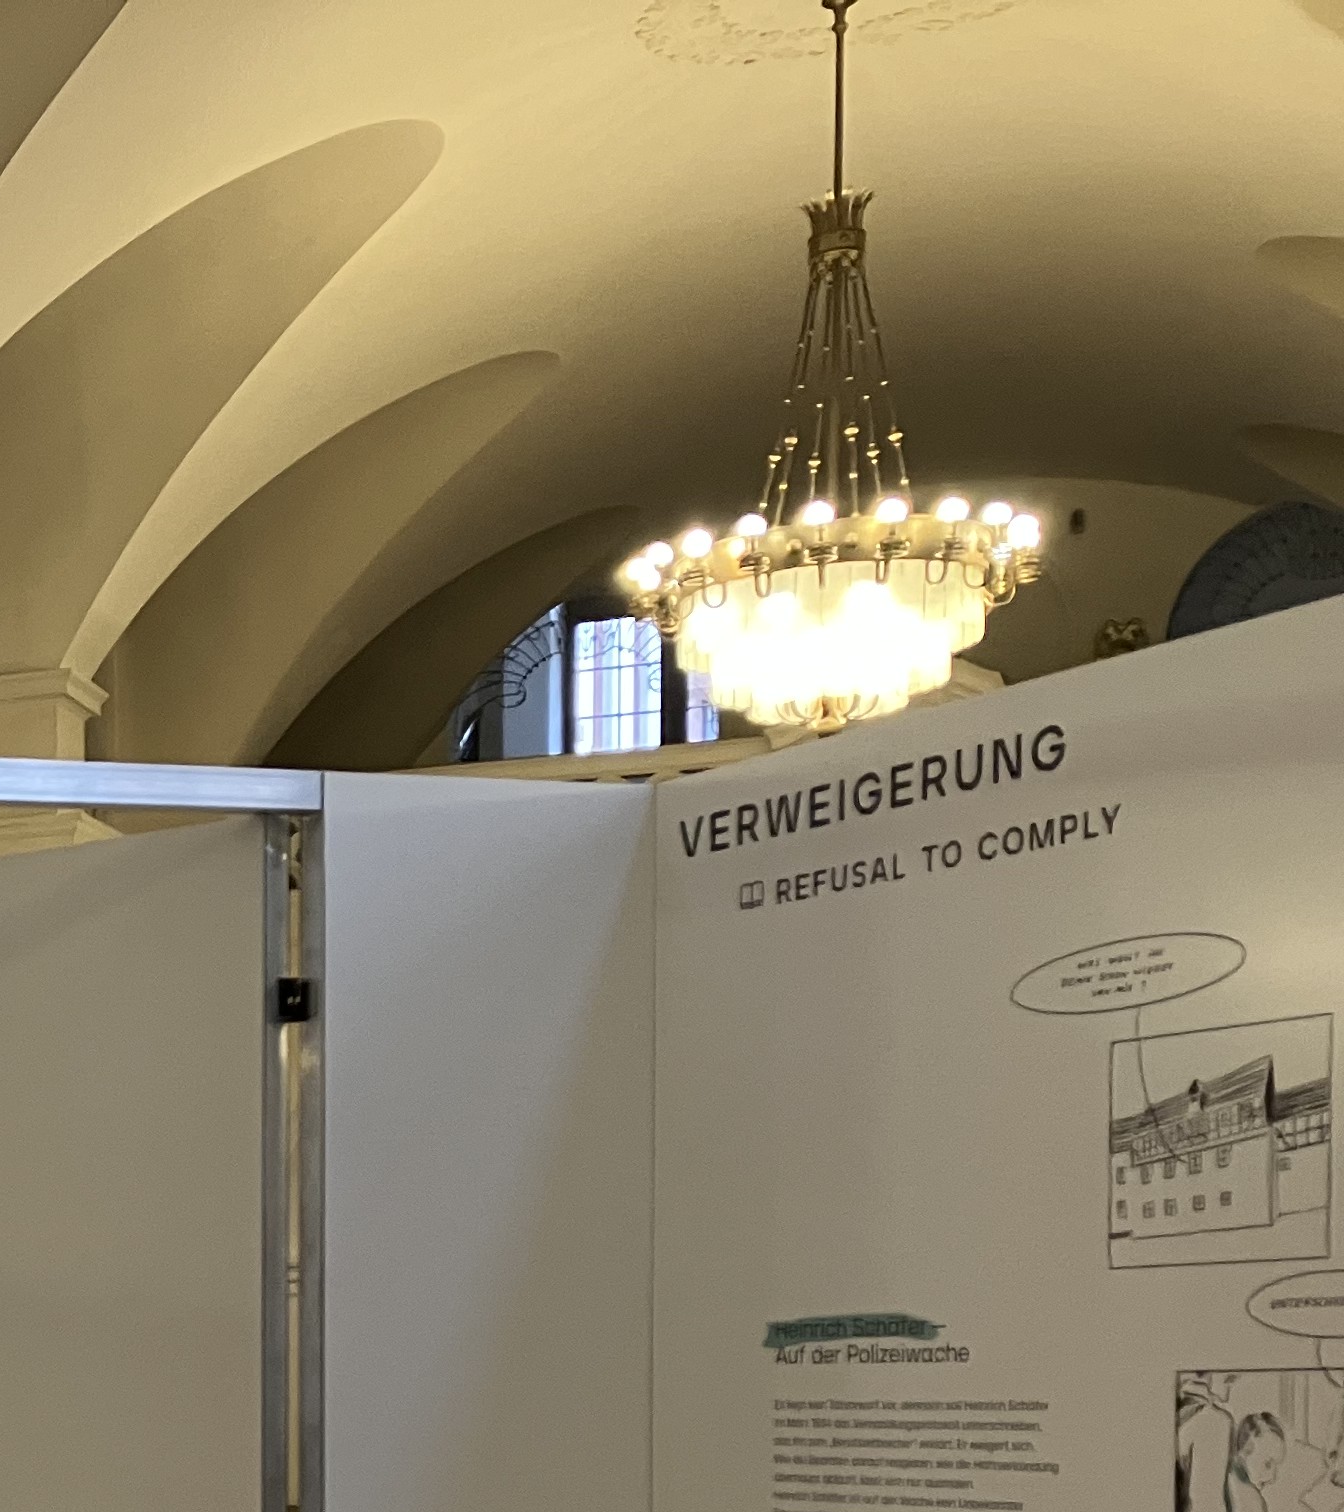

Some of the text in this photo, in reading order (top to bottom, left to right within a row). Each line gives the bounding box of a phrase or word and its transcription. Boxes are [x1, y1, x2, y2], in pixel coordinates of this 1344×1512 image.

[679, 724, 1067, 857] VERWEIGERUNG
[775, 803, 1123, 904] REFUSAL TO COMPLY
[775, 1343, 970, 1364] Auf der Polizeiwache
